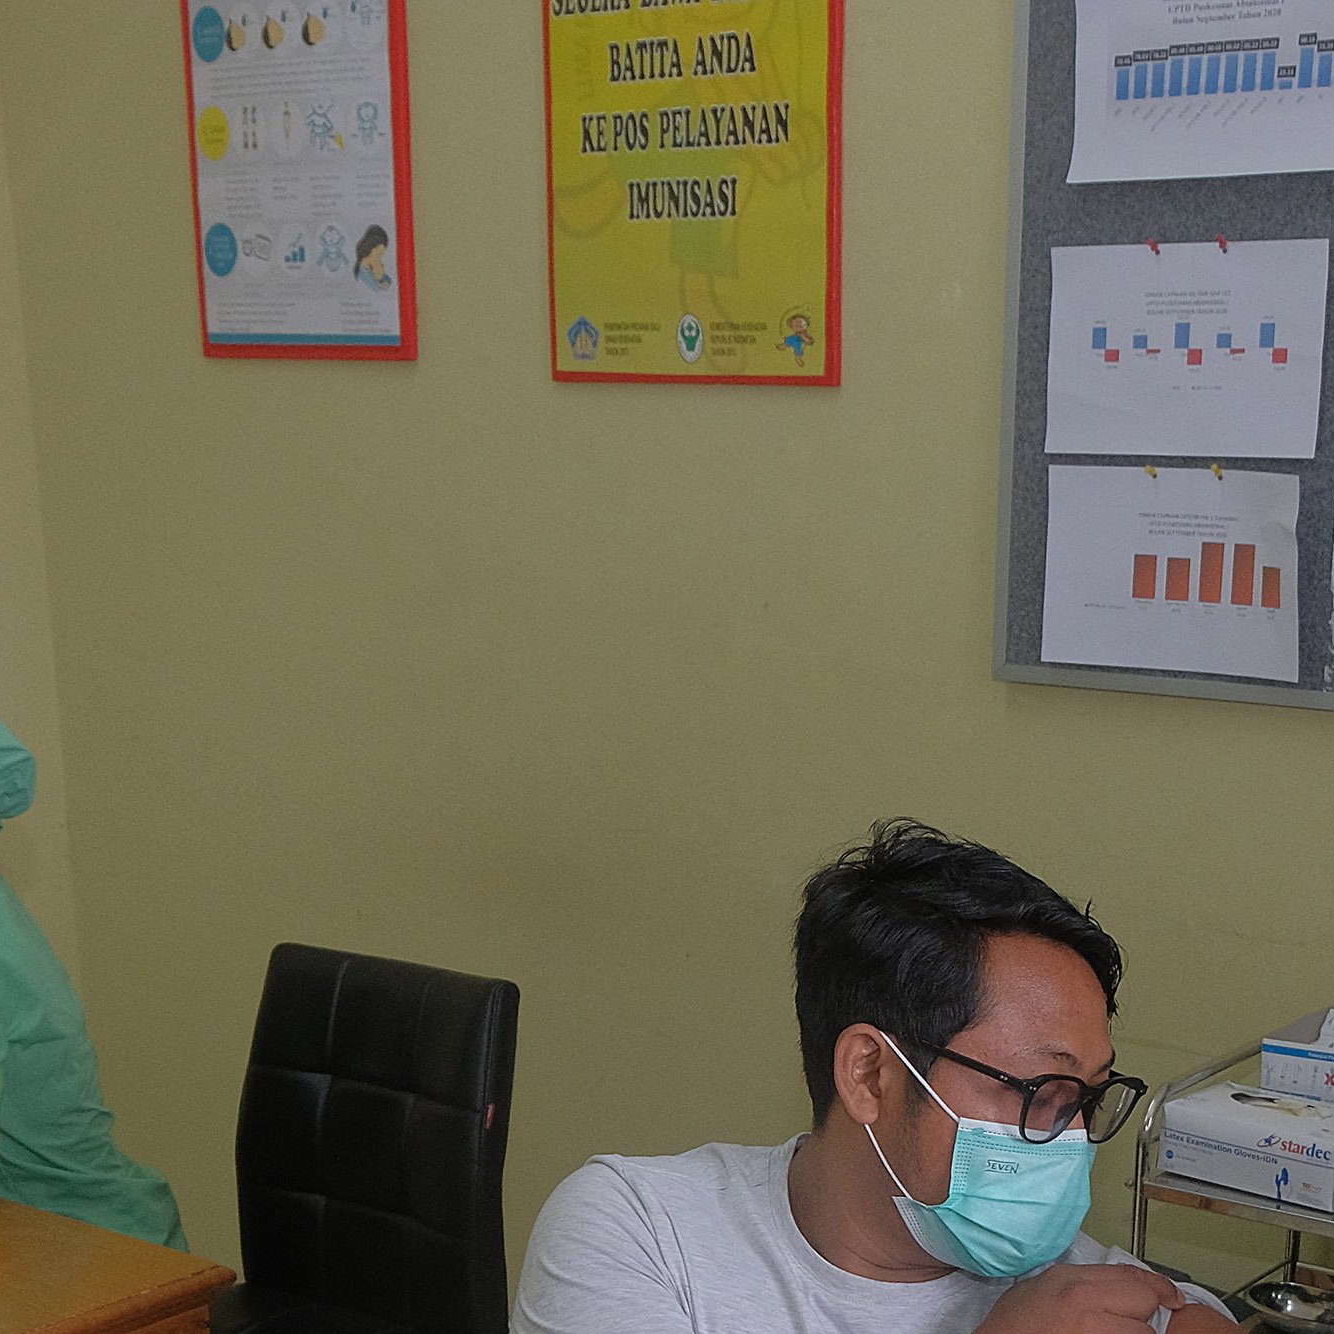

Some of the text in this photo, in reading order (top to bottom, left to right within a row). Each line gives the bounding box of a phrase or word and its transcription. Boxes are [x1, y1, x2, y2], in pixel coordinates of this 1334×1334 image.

[609, 32, 756, 81] BATITA ANDA
[581, 102, 790, 153] KE POS PELAYANAN
[628, 177, 737, 220] IMUNISASI
[1185, 1135, 1232, 1155] Examination
[1280, 1139, 1332, 1161] stardec
[986, 1159, 1019, 1174] SEVEN
